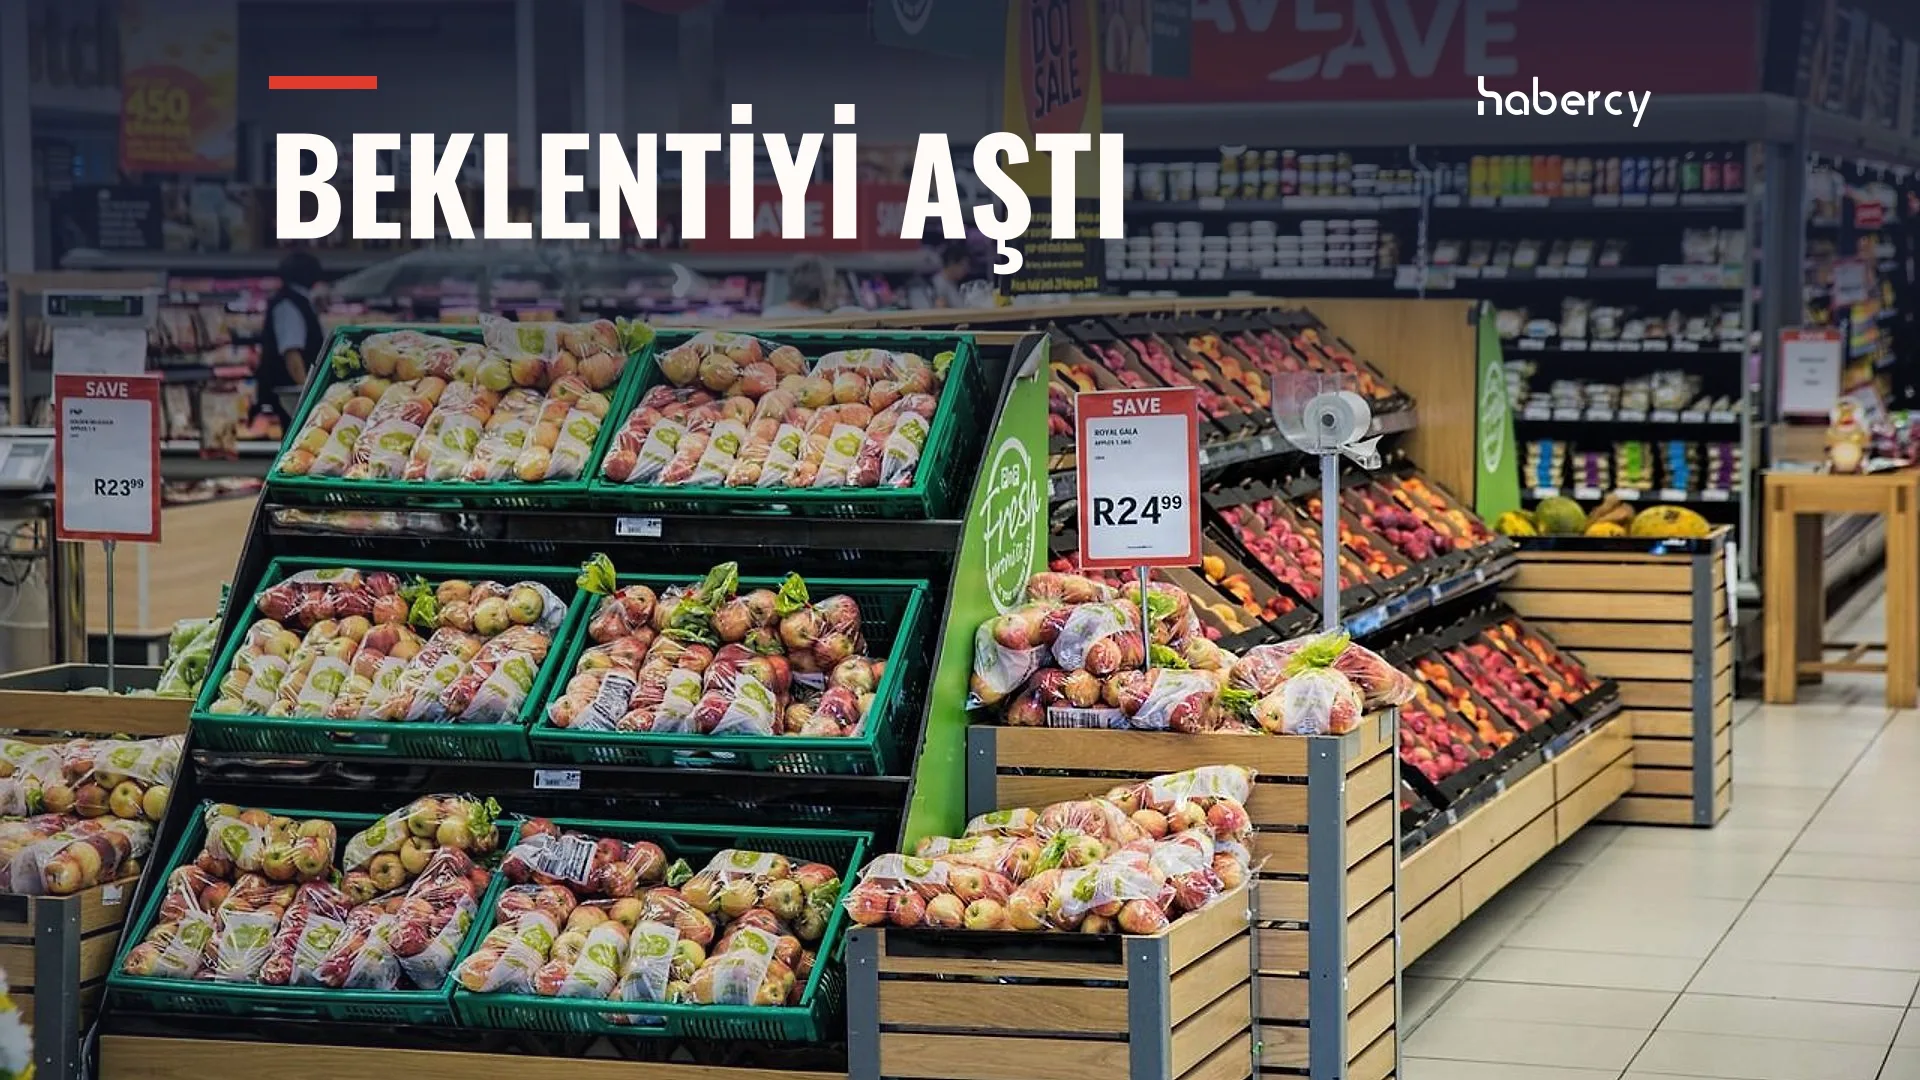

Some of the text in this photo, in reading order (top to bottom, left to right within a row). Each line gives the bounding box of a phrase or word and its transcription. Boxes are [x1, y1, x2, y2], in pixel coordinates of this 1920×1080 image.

[1267, 0, 1519, 81] AVE
[1034, 50, 1082, 118] SALE
[86, 381, 129, 398] SAVE
[1112, 397, 1160, 415] SAVE
[1094, 427, 1138, 436] ROYAL GALA
